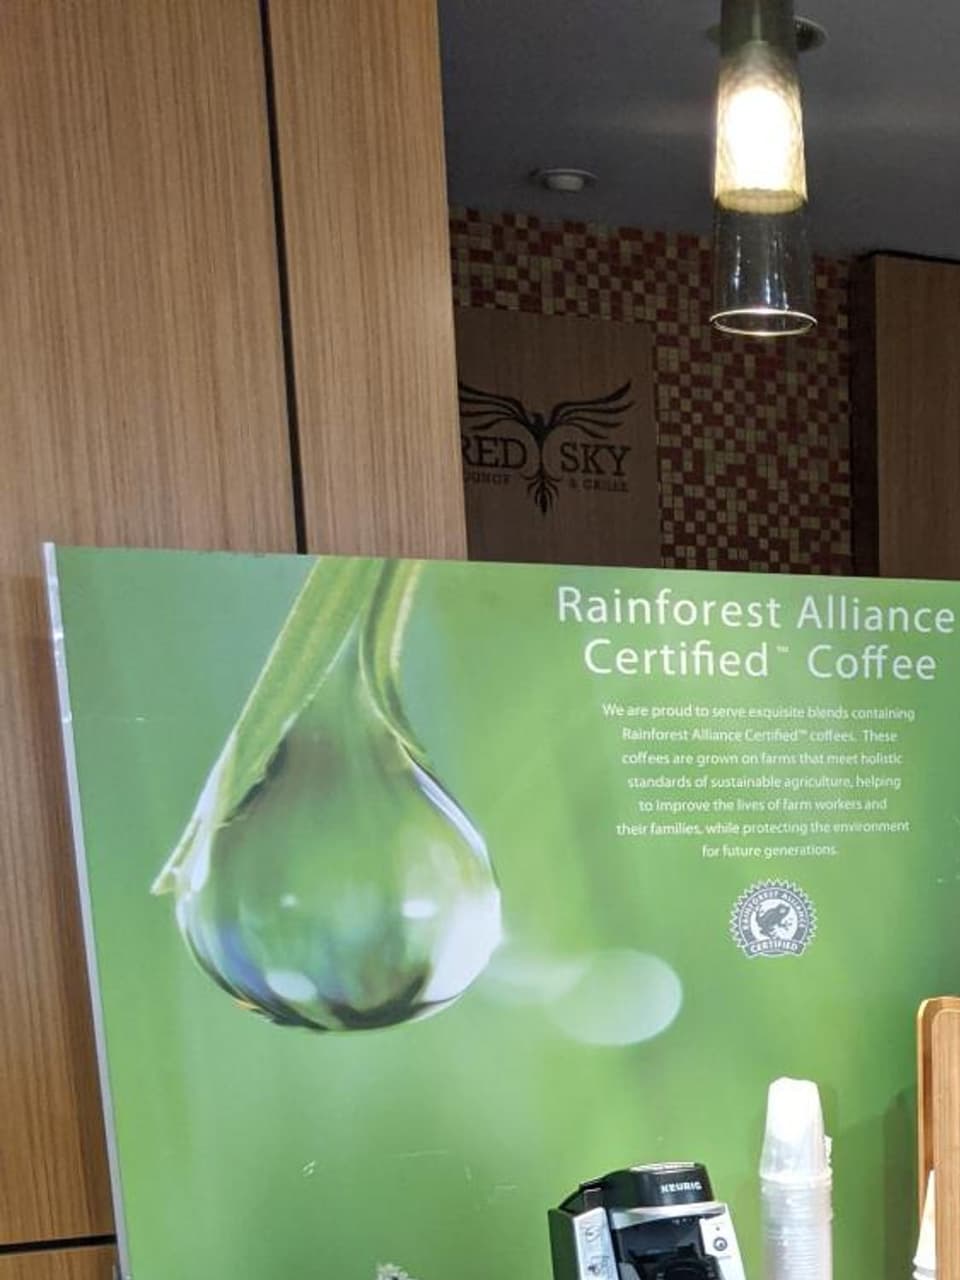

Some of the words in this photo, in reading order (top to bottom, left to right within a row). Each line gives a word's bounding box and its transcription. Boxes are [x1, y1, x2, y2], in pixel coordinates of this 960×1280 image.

[560, 442, 632, 476] SKY
[558, 586, 781, 629] Rainforest
[797, 595, 955, 633] Alliance
[807, 644, 937, 680] Coffee
[602, 704, 624, 717] We
[627, 706, 649, 717] are
[651, 704, 693, 719] proud
[695, 705, 709, 717] to
[712, 706, 747, 718] serve
[749, 706, 805, 721] exquisite
[808, 706, 849, 719] blends
[851, 708, 916, 721] containing
[622, 727, 688, 741] Rainforest
[691, 728, 742, 741] Alliance
[810, 729, 856, 742] coffees.
[863, 730, 898, 742] These
[621, 751, 669, 764] coffees
[673, 754, 694, 764] are
[697, 754, 738, 767] grown
[742, 754, 758, 764] on
[761, 752, 796, 764] farms
[800, 752, 824, 764] that
[827, 754, 859, 764] meet
[861, 752, 902, 765] holistic
[627, 775, 692, 788] standards
[695, 775, 708, 788] of
[711, 775, 781, 788] sustainable
[856, 775, 902, 790] helping
[639, 800, 653, 811] to
[656, 799, 711, 814] improve
[713, 798, 735, 811] the
[737, 798, 764, 811] lives
[767, 798, 780, 811] of
[782, 798, 812, 811] farm
[816, 798, 863, 810] workers
[864, 798, 888, 810] and
[616, 823, 648, 836] their
[705, 822, 740, 835] while
[743, 822, 808, 836] protecting
[810, 821, 831, 833] the
[833, 821, 910, 833] environment
[702, 844, 719, 857] for
[722, 844, 762, 857] future
[764, 845, 837, 859] generations.
[750, 941, 798, 953] CERTIFIED
[661, 1181, 702, 1193] KEURIG
